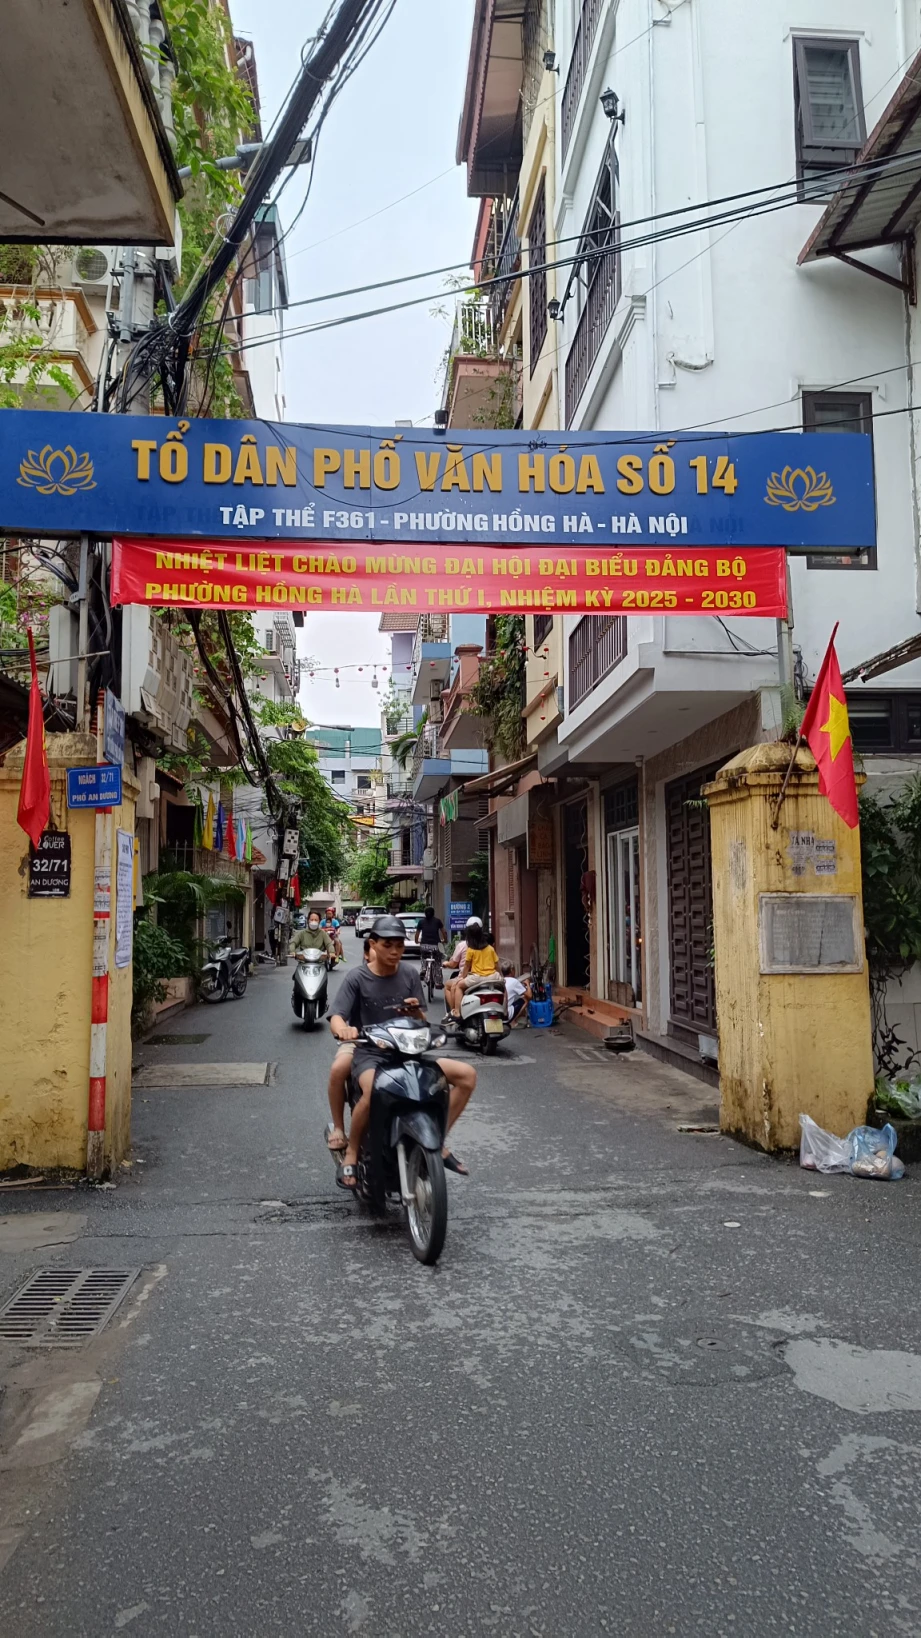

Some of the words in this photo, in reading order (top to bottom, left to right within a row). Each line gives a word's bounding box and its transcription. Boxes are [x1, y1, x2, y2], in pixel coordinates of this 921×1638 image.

[131, 419, 189, 483] TỔ
[203, 434, 297, 486] DÂN
[313, 434, 403, 490] PHỐ
[415, 443, 503, 491] VĂN
[518, 444, 605, 494] HÓA
[617, 438, 676, 495] SỐ
[689, 455, 738, 494] 14
[219, 504, 265, 529] TẬP
[271, 502, 316, 528] THỂ
[323, 509, 375, 529] F361
[394, 506, 488, 532] PHƯỜNG
[492, 508, 556, 533] HỒNG
[562, 511, 594, 534] HÀ
[611, 511, 643, 535] HÀ
[648, 512, 688, 537] NỘI
[156, 549, 228, 574] NHIỆT
[235, 551, 285, 575] LIỆT
[292, 552, 357, 574] CHÀO
[365, 553, 437, 575] MỪNG
[444, 558, 484, 579] ĐẠI
[492, 555, 531, 579] HỘI
[538, 559, 578, 580] ĐẠI
[585, 552, 638, 577] BIỂU
[644, 554, 709, 577] ĐẢNG
[716, 556, 747, 581] BỘ
[145, 580, 248, 603] PHƯỜNG
[255, 580, 323, 604] HỒNG
[331, 584, 363, 605] HÀ
[371, 582, 417, 605] LẦN
[425, 585, 472, 606] THỨ
[478, 589, 492, 608] I,
[500, 586, 578, 611] NHIỆM
[585, 587, 614, 607] KỲ
[621, 590, 678, 608] 2025
[701, 590, 757, 608] 2030
[72, 792, 87, 802] PHỐ
[88, 793, 99, 801] AN
[32, 858, 68, 872] 32/71
[30, 878, 41, 886] AN
